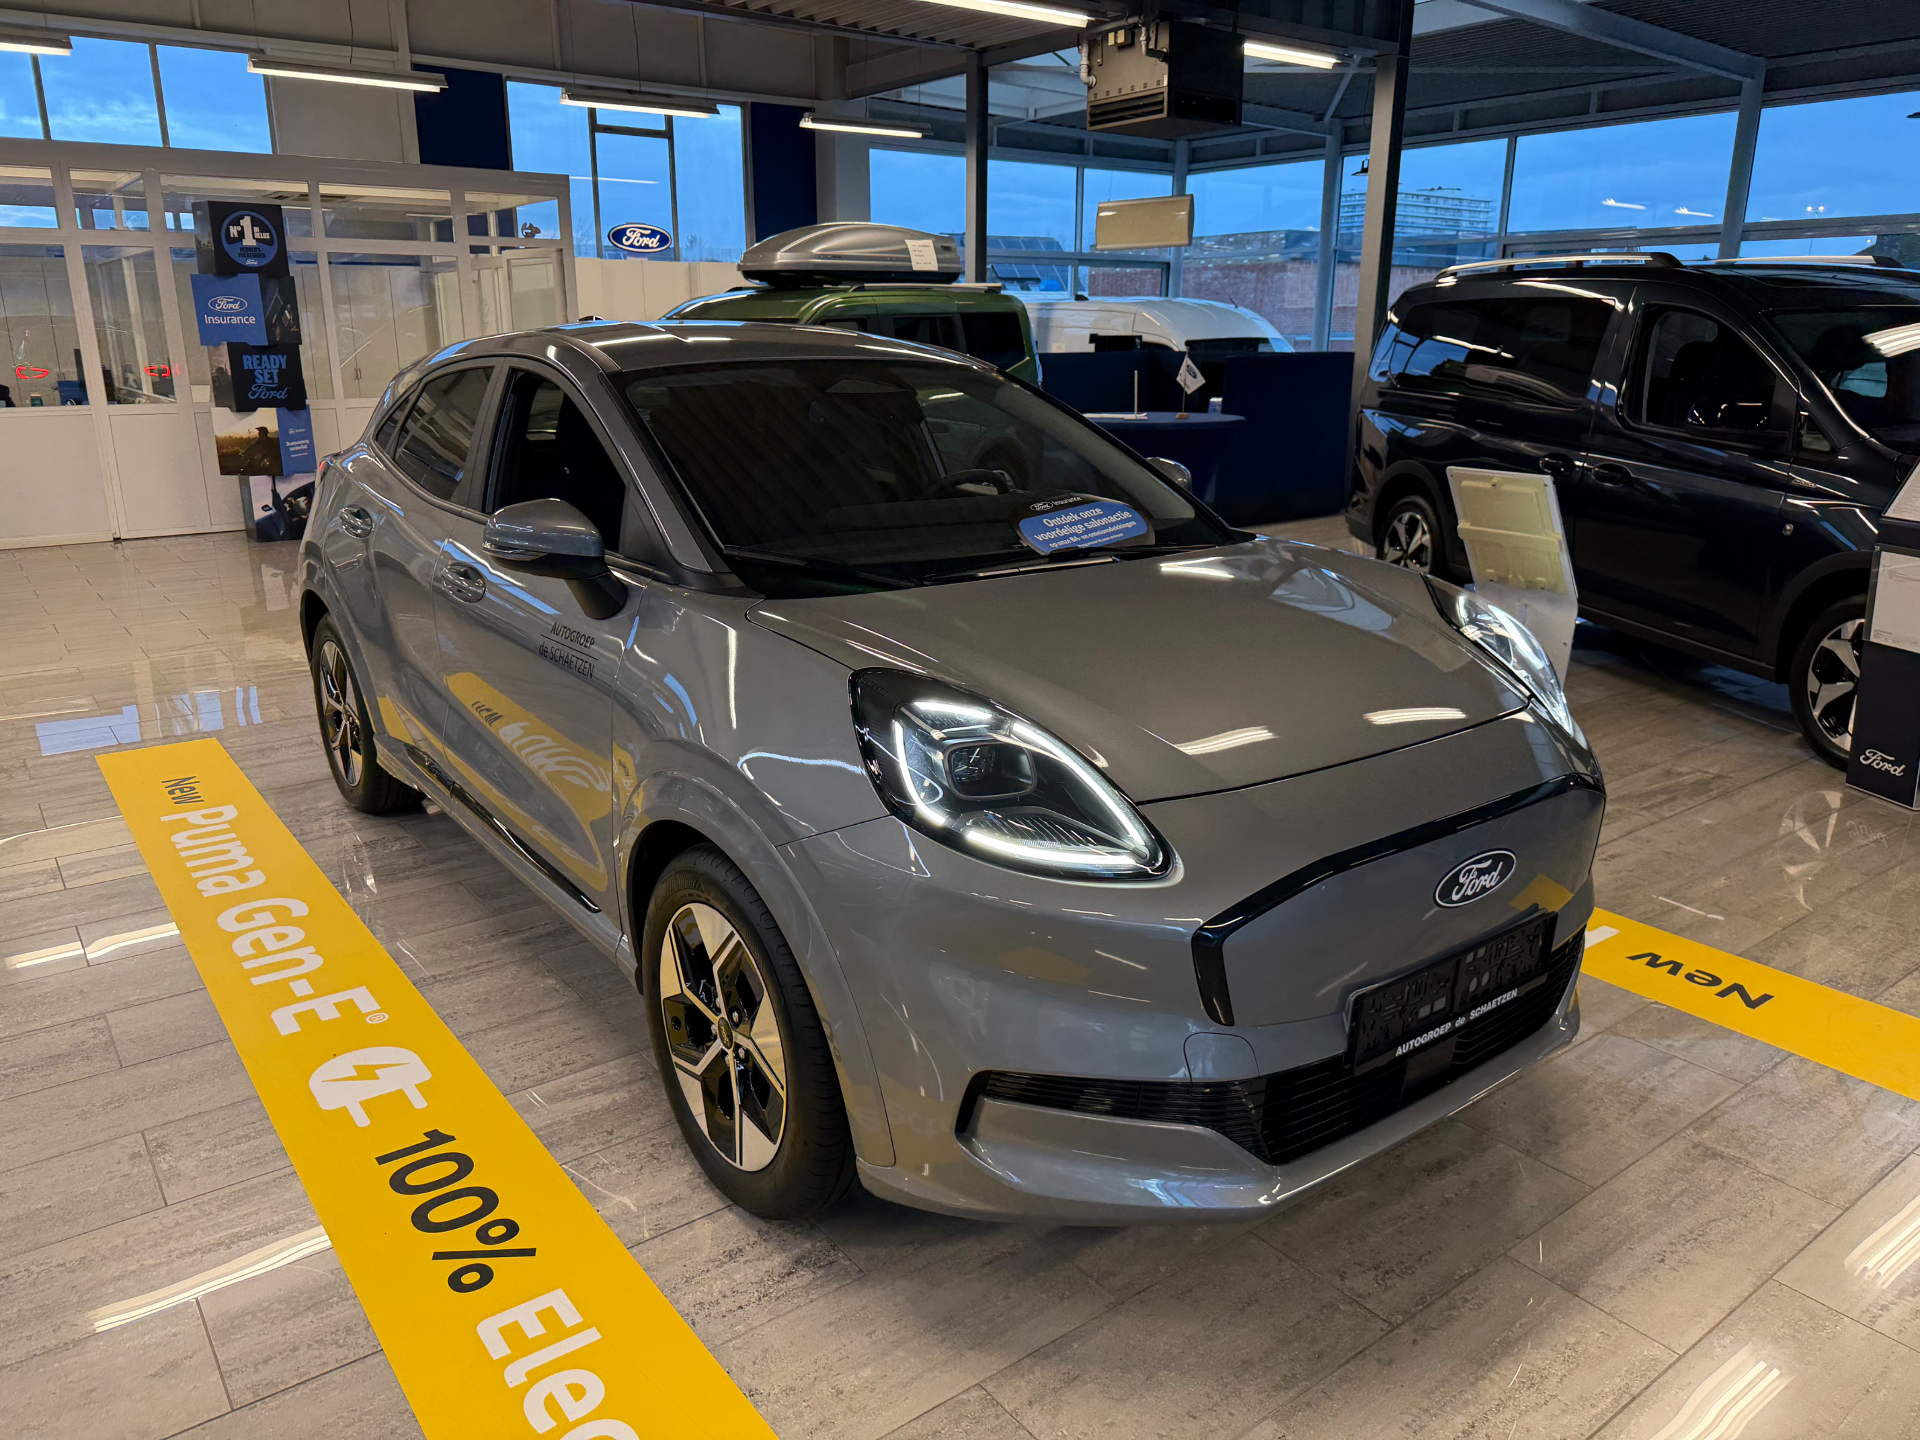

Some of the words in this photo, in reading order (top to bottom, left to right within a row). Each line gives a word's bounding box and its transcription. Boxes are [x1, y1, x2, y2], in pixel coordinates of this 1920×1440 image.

[622, 228, 661, 248] Ford
[215, 298, 241, 310] Ford
[204, 314, 256, 325] Insurance
[242, 354, 287, 370] READY
[253, 369, 279, 384] SET
[248, 383, 289, 399] Ford
[1034, 525, 1086, 541] voordelige
[1084, 511, 1132, 529] salonactie
[1042, 512, 1082, 527] Ontdek
[1079, 508, 1104, 519] onze
[550, 622, 595, 649] AUTOGROEP
[539, 641, 549, 658] de
[549, 645, 595, 679] SCHAETZEN
[1859, 748, 1906, 777] Ford
[161, 775, 205, 805] New
[159, 804, 266, 898] Puma
[1451, 858, 1504, 901] Ford
[1625, 951, 1776, 1010] New
[1394, 1022, 1452, 1057] AUTOGROEP
[1454, 1016, 1466, 1028] de
[1469, 987, 1519, 1020] SCHAETZEN
[374, 1128, 537, 1293] 100%
